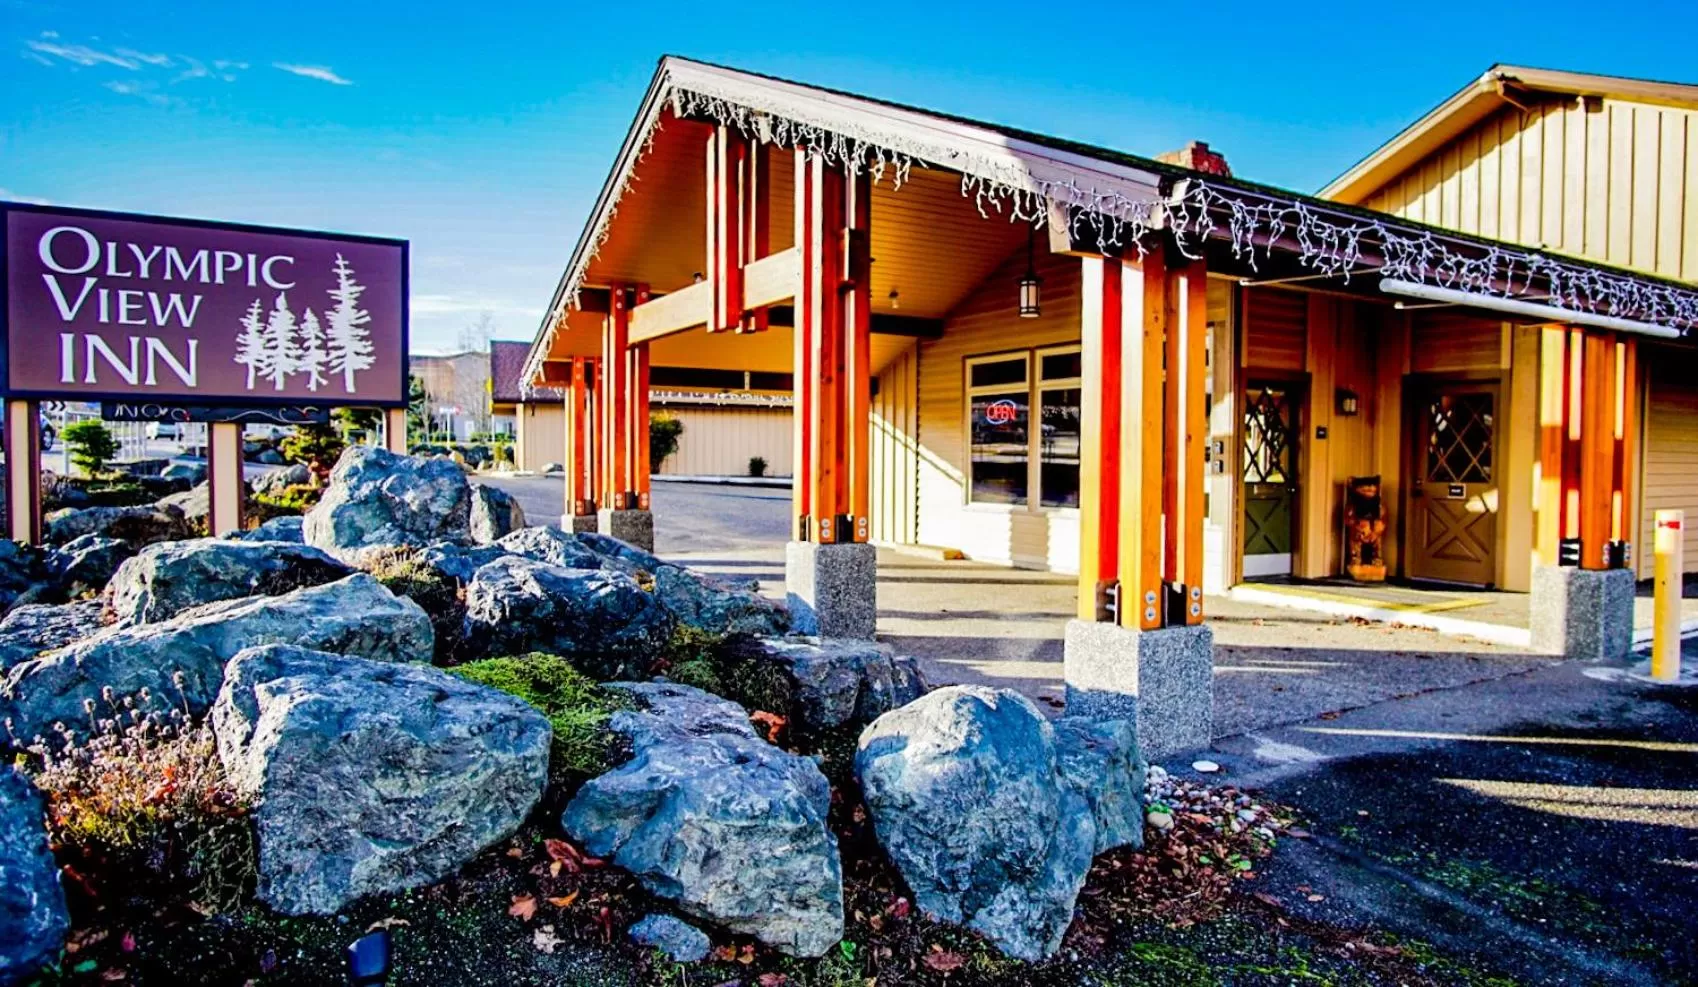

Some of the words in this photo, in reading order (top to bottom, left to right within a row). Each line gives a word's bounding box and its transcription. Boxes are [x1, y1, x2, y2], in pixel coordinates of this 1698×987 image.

[38, 226, 296, 289] OLYMPIC
[42, 274, 203, 328] VIEW
[60, 333, 198, 387] INN
[986, 404, 1017, 420] OPEN
